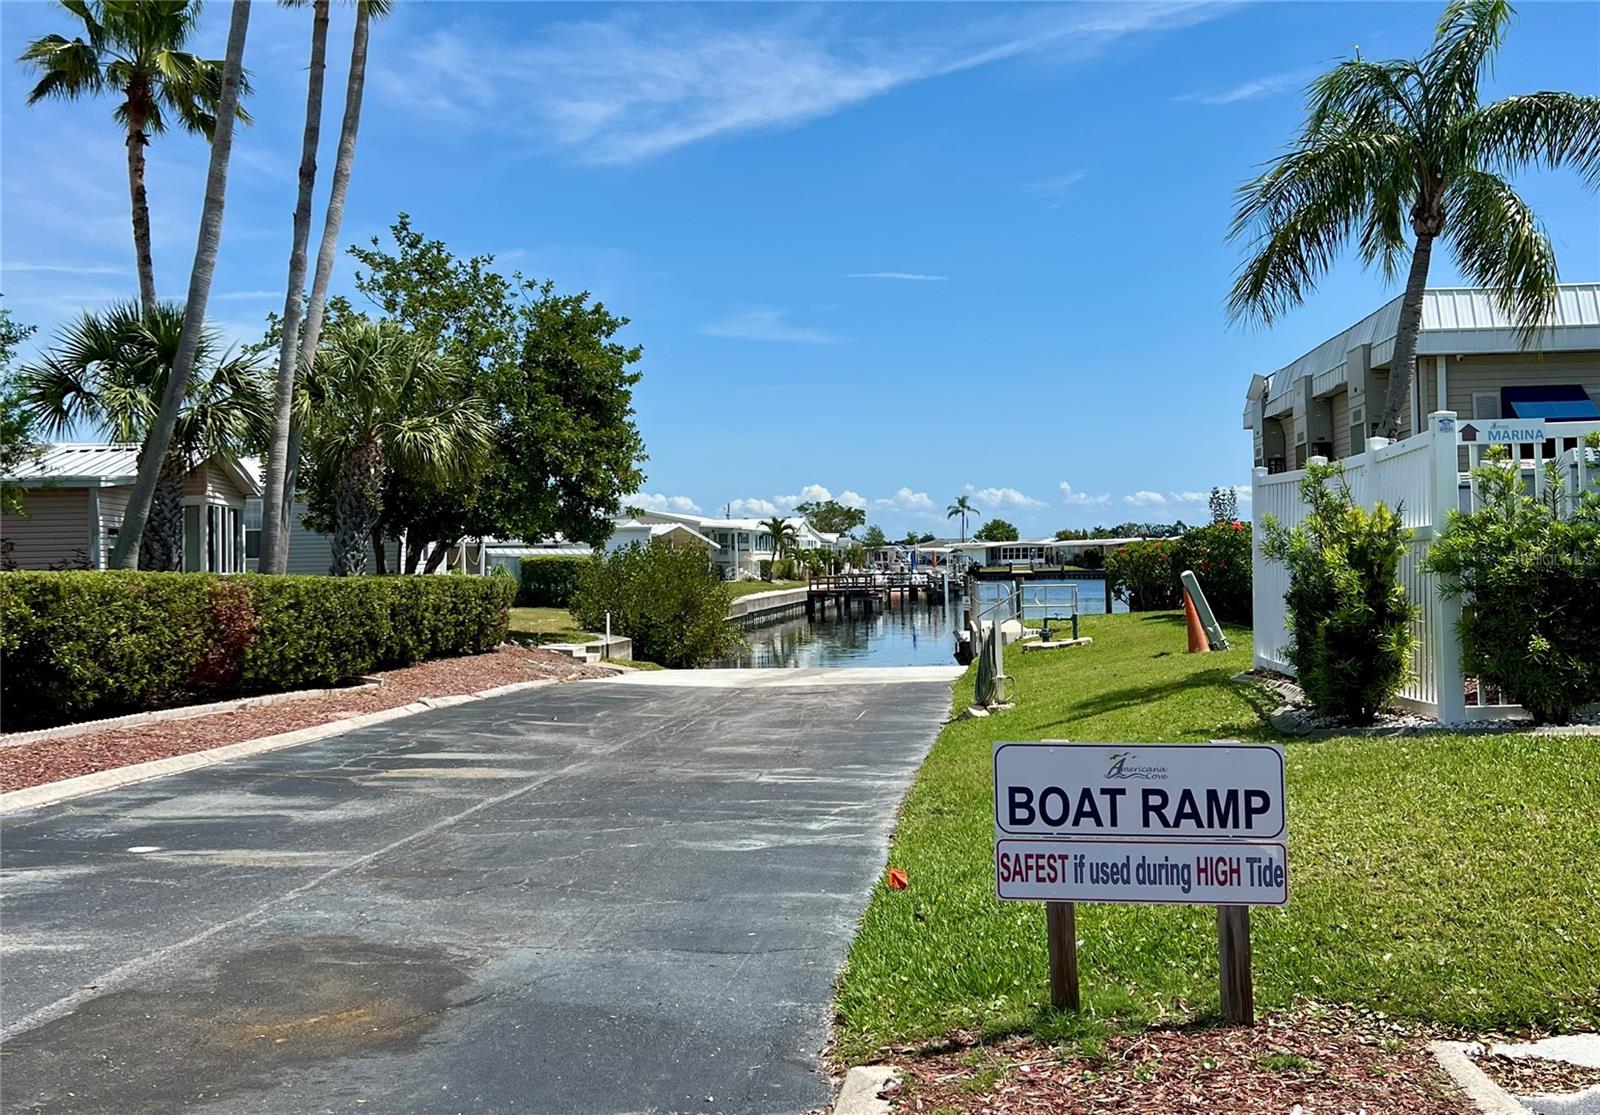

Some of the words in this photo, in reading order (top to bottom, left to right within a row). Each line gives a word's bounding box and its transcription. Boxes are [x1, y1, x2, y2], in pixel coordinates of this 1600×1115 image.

[1488, 429, 1545, 441] MARINA
[1107, 757, 1168, 776] Americana
[1145, 772, 1168, 780] Cove
[1008, 786, 1126, 828] BOAT
[1142, 788, 1271, 829] RAMP
[1000, 853, 1069, 883] SAFEST
[1074, 855, 1085, 883] if
[1090, 855, 1131, 885] used
[1136, 856, 1191, 894] during
[1196, 856, 1241, 886] HIGH
[1246, 857, 1284, 888] Tide
